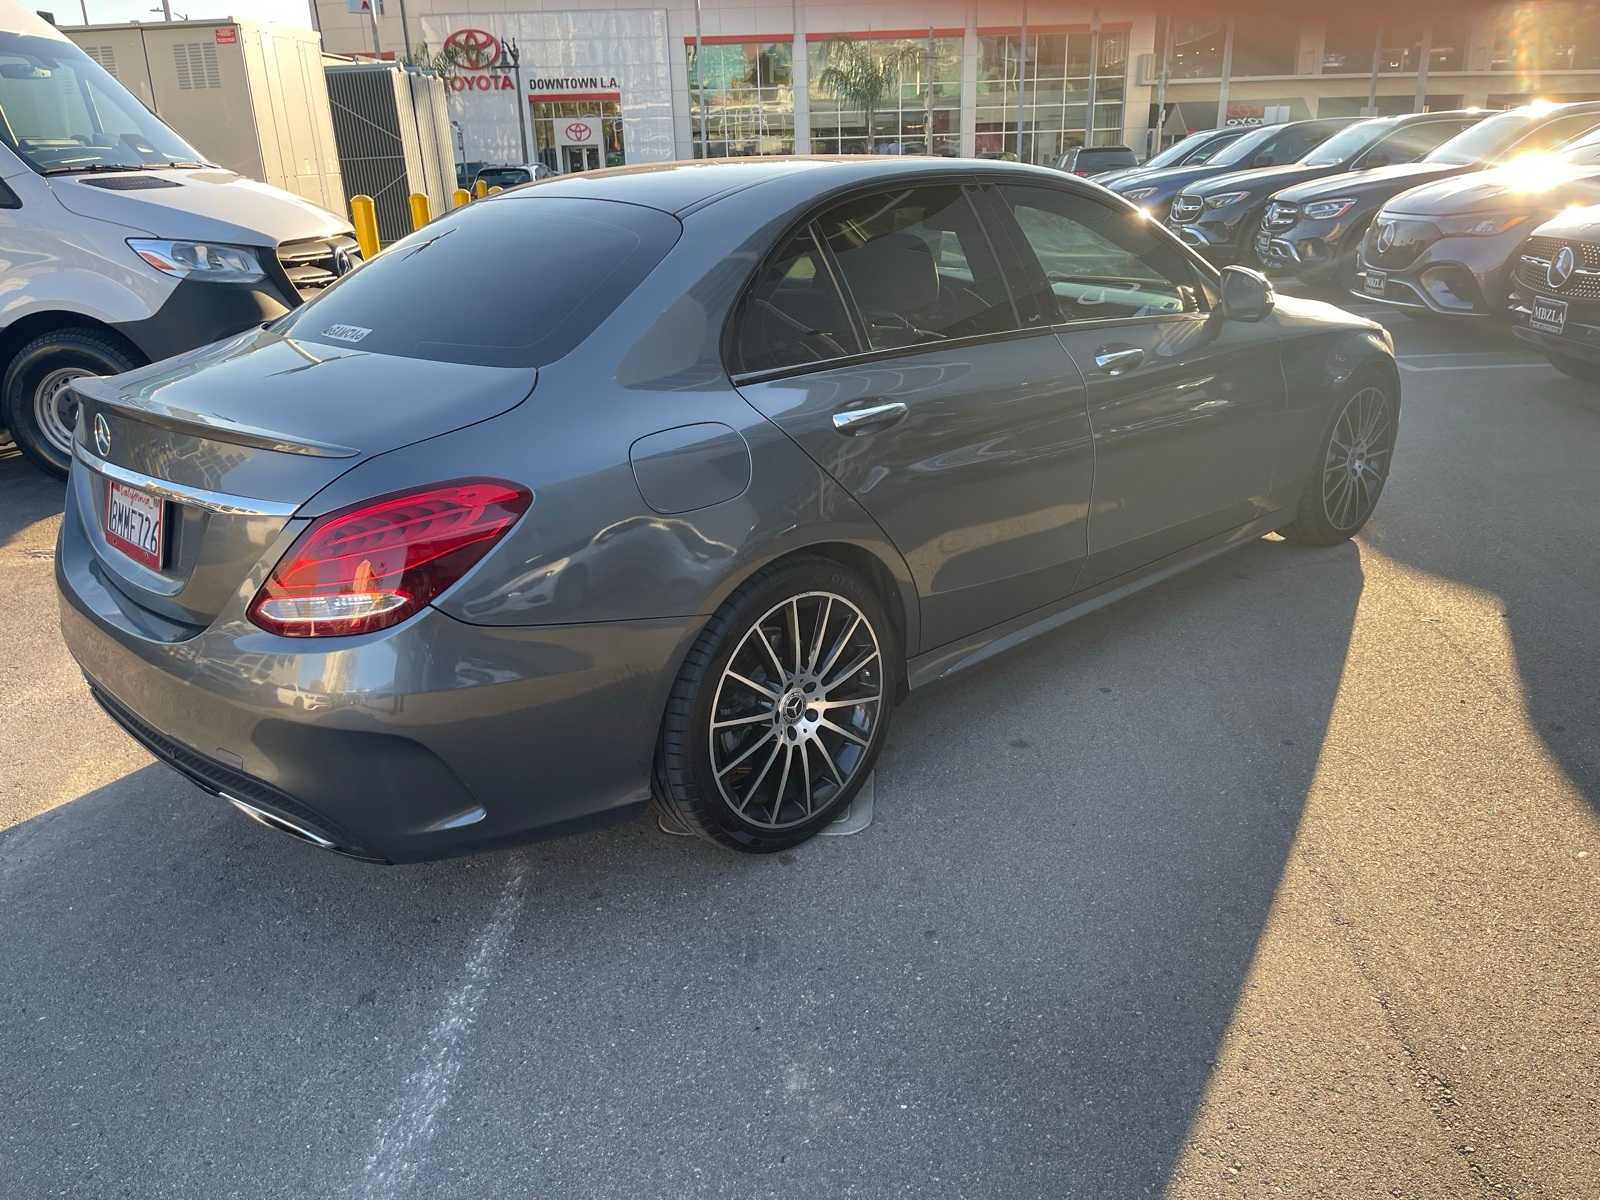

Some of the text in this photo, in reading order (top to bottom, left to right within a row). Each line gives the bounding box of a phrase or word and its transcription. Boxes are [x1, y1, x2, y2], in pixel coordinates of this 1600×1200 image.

[529, 77, 621, 90] DOWNTOWN L.A.
[1534, 305, 1564, 324] MBZLA
